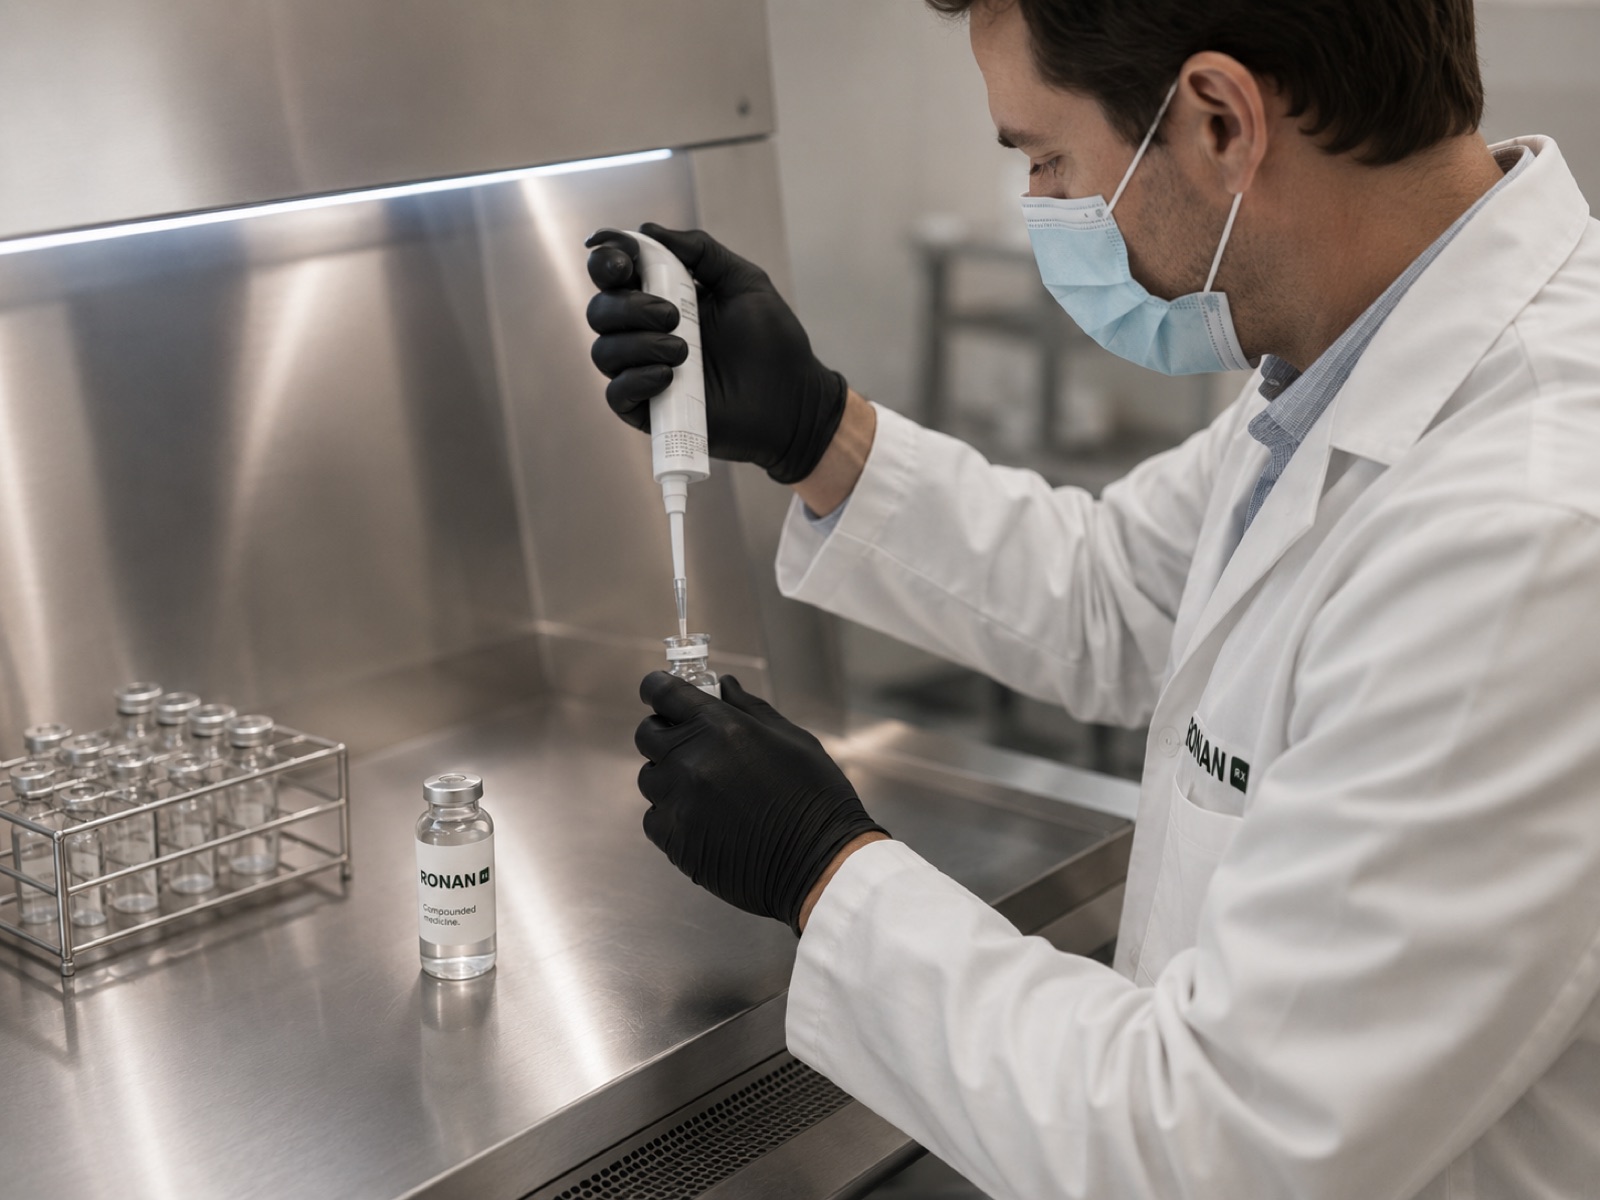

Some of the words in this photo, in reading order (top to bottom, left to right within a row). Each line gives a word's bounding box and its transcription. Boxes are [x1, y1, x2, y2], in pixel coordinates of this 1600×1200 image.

[1234, 768, 1246, 782] RX
[421, 870, 475, 888] RONAN
[422, 904, 476, 916] Compounded
